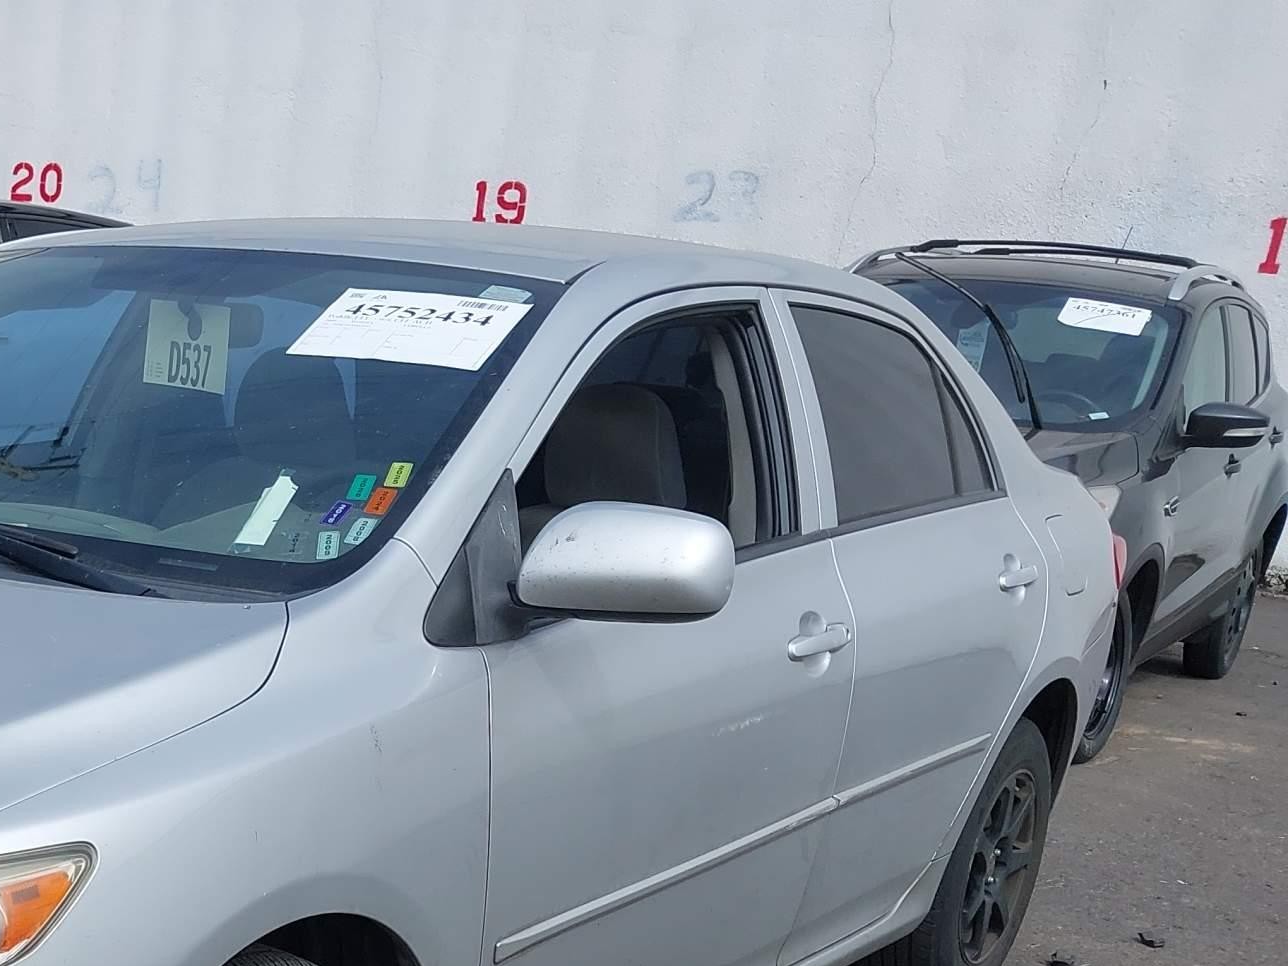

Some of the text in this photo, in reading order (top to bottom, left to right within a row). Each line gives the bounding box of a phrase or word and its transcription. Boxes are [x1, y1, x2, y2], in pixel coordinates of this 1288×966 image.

[10, 162, 63, 203] 20
[472, 180, 527, 225] 19
[344, 302, 495, 328] 45752434
[167, 340, 212, 389] D537
